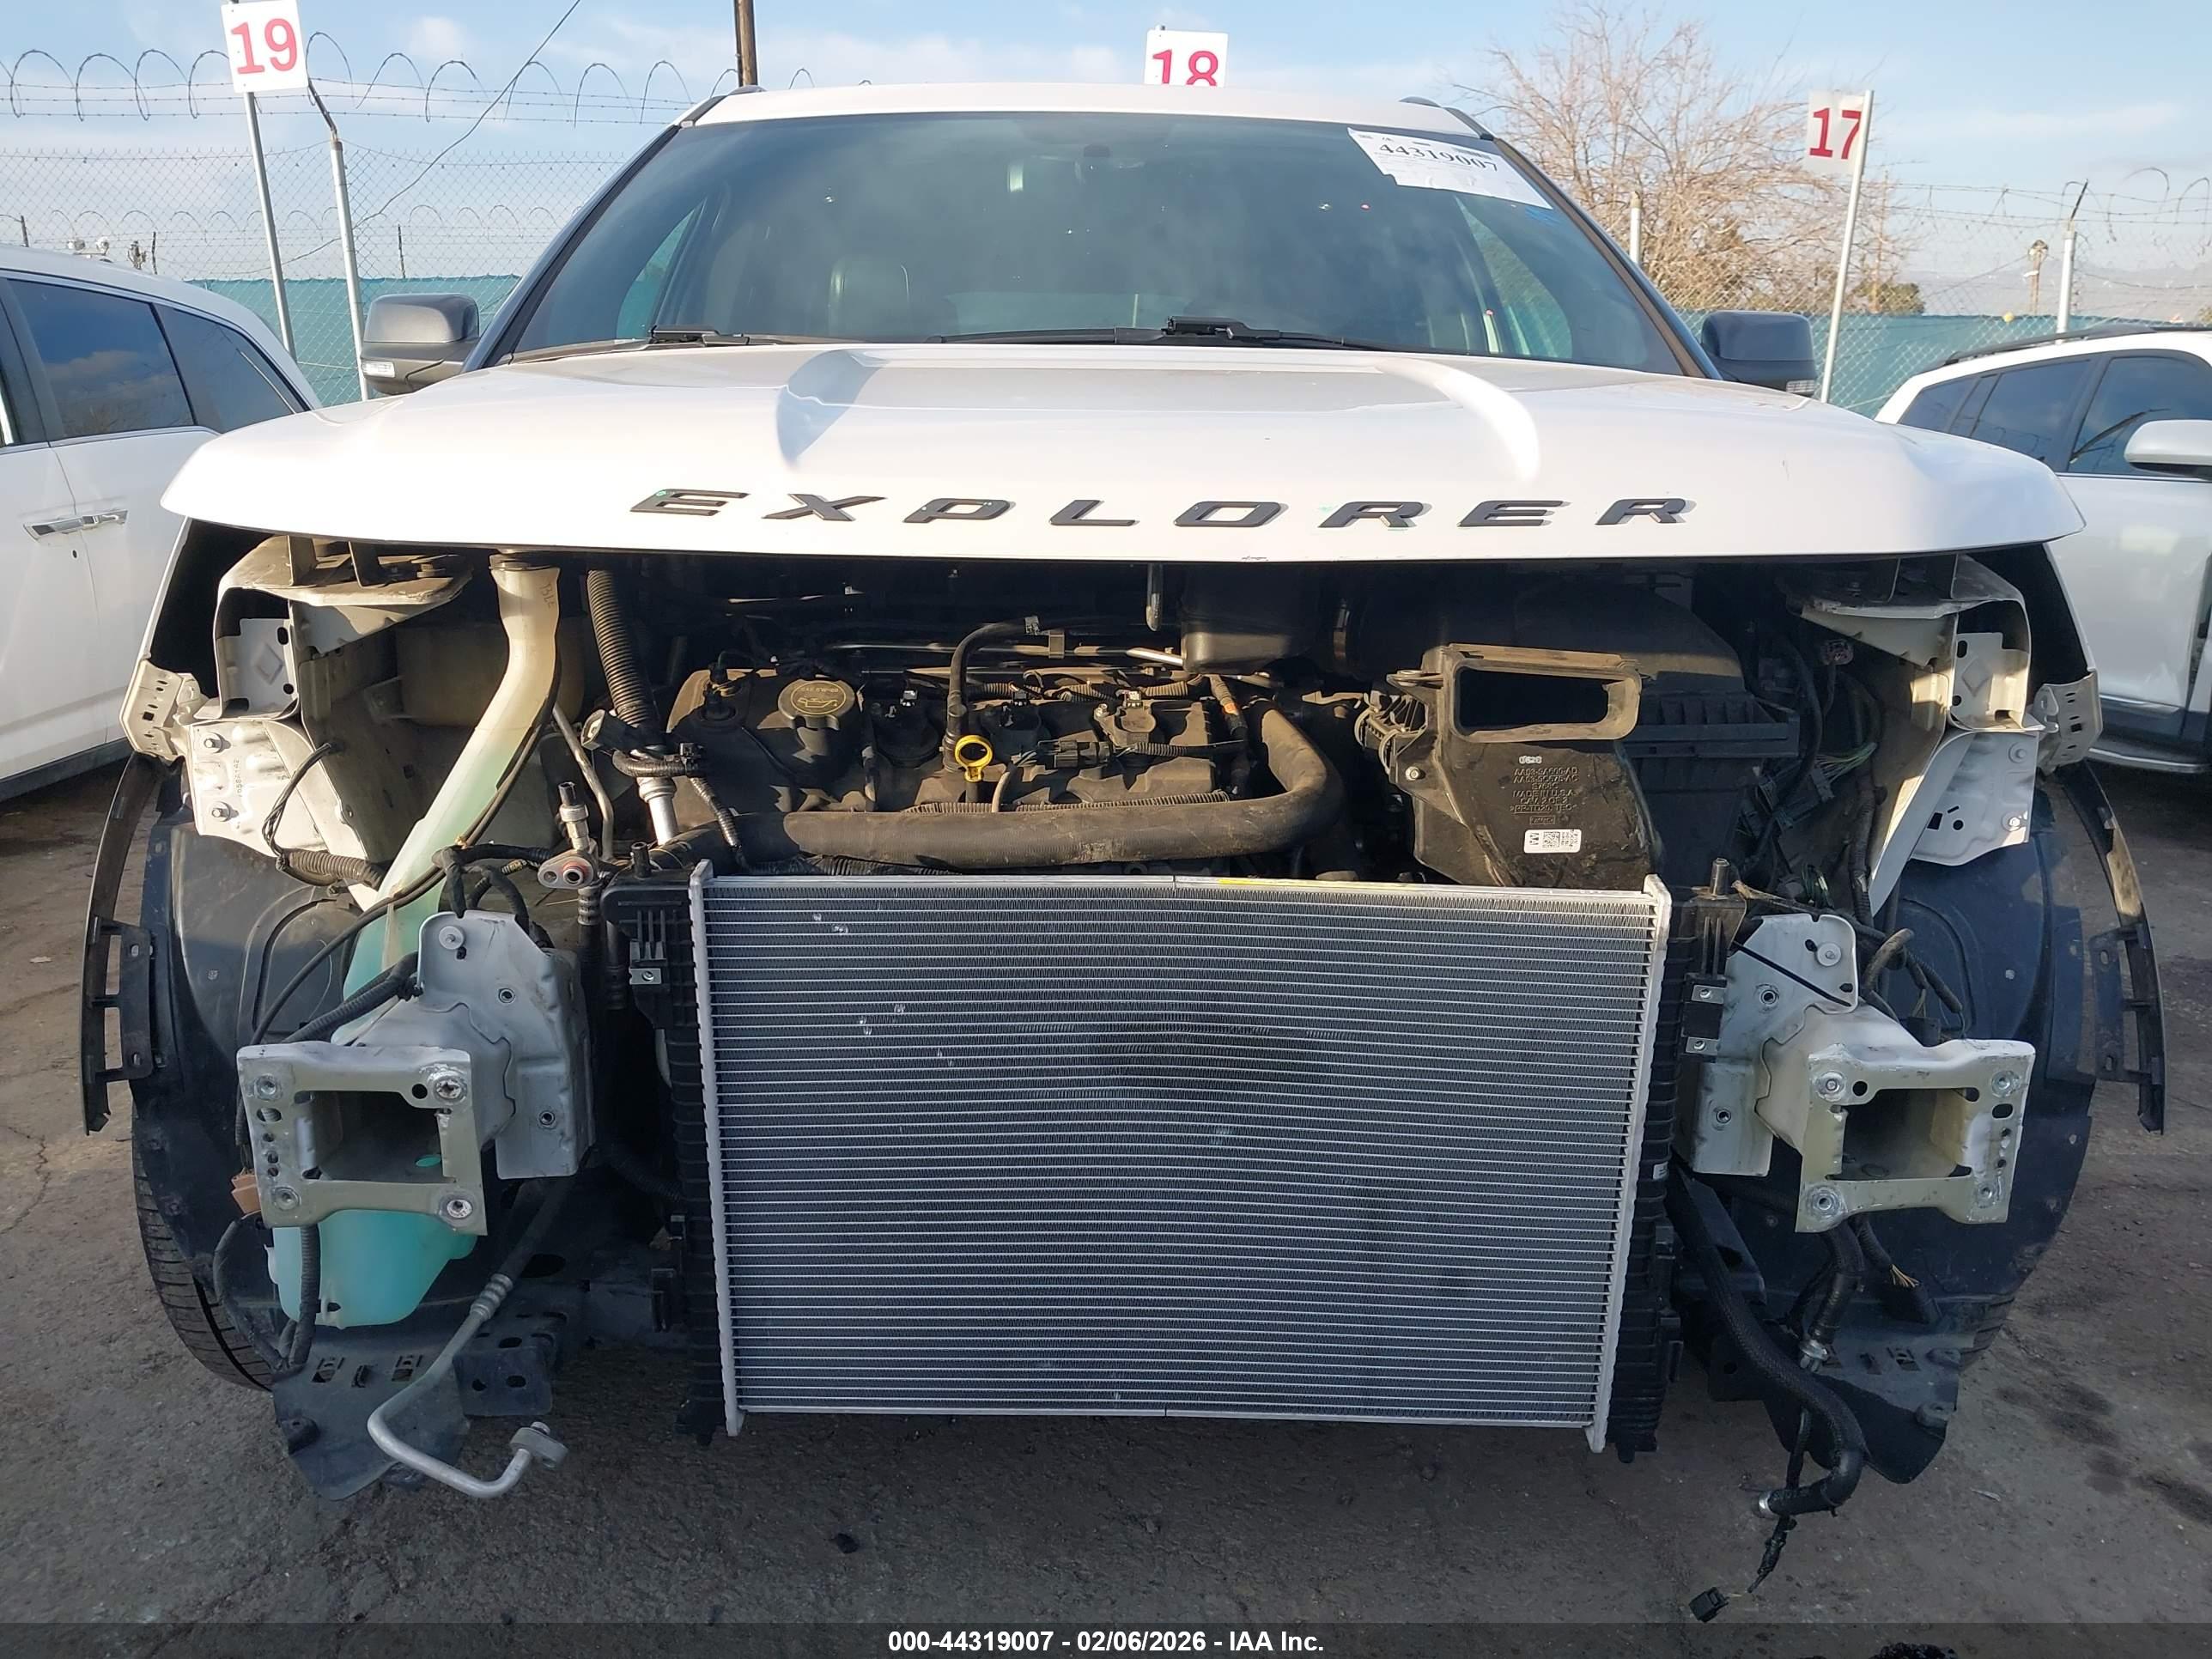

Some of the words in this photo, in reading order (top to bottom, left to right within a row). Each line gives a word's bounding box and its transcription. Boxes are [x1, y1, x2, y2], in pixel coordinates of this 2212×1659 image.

[231, 18, 297, 75] 19
[1152, 49, 1218, 86] 18
[1809, 107, 1862, 160] 17
[1380, 143, 1498, 172] 44319007
[629, 489, 1688, 528] EXPLORER
